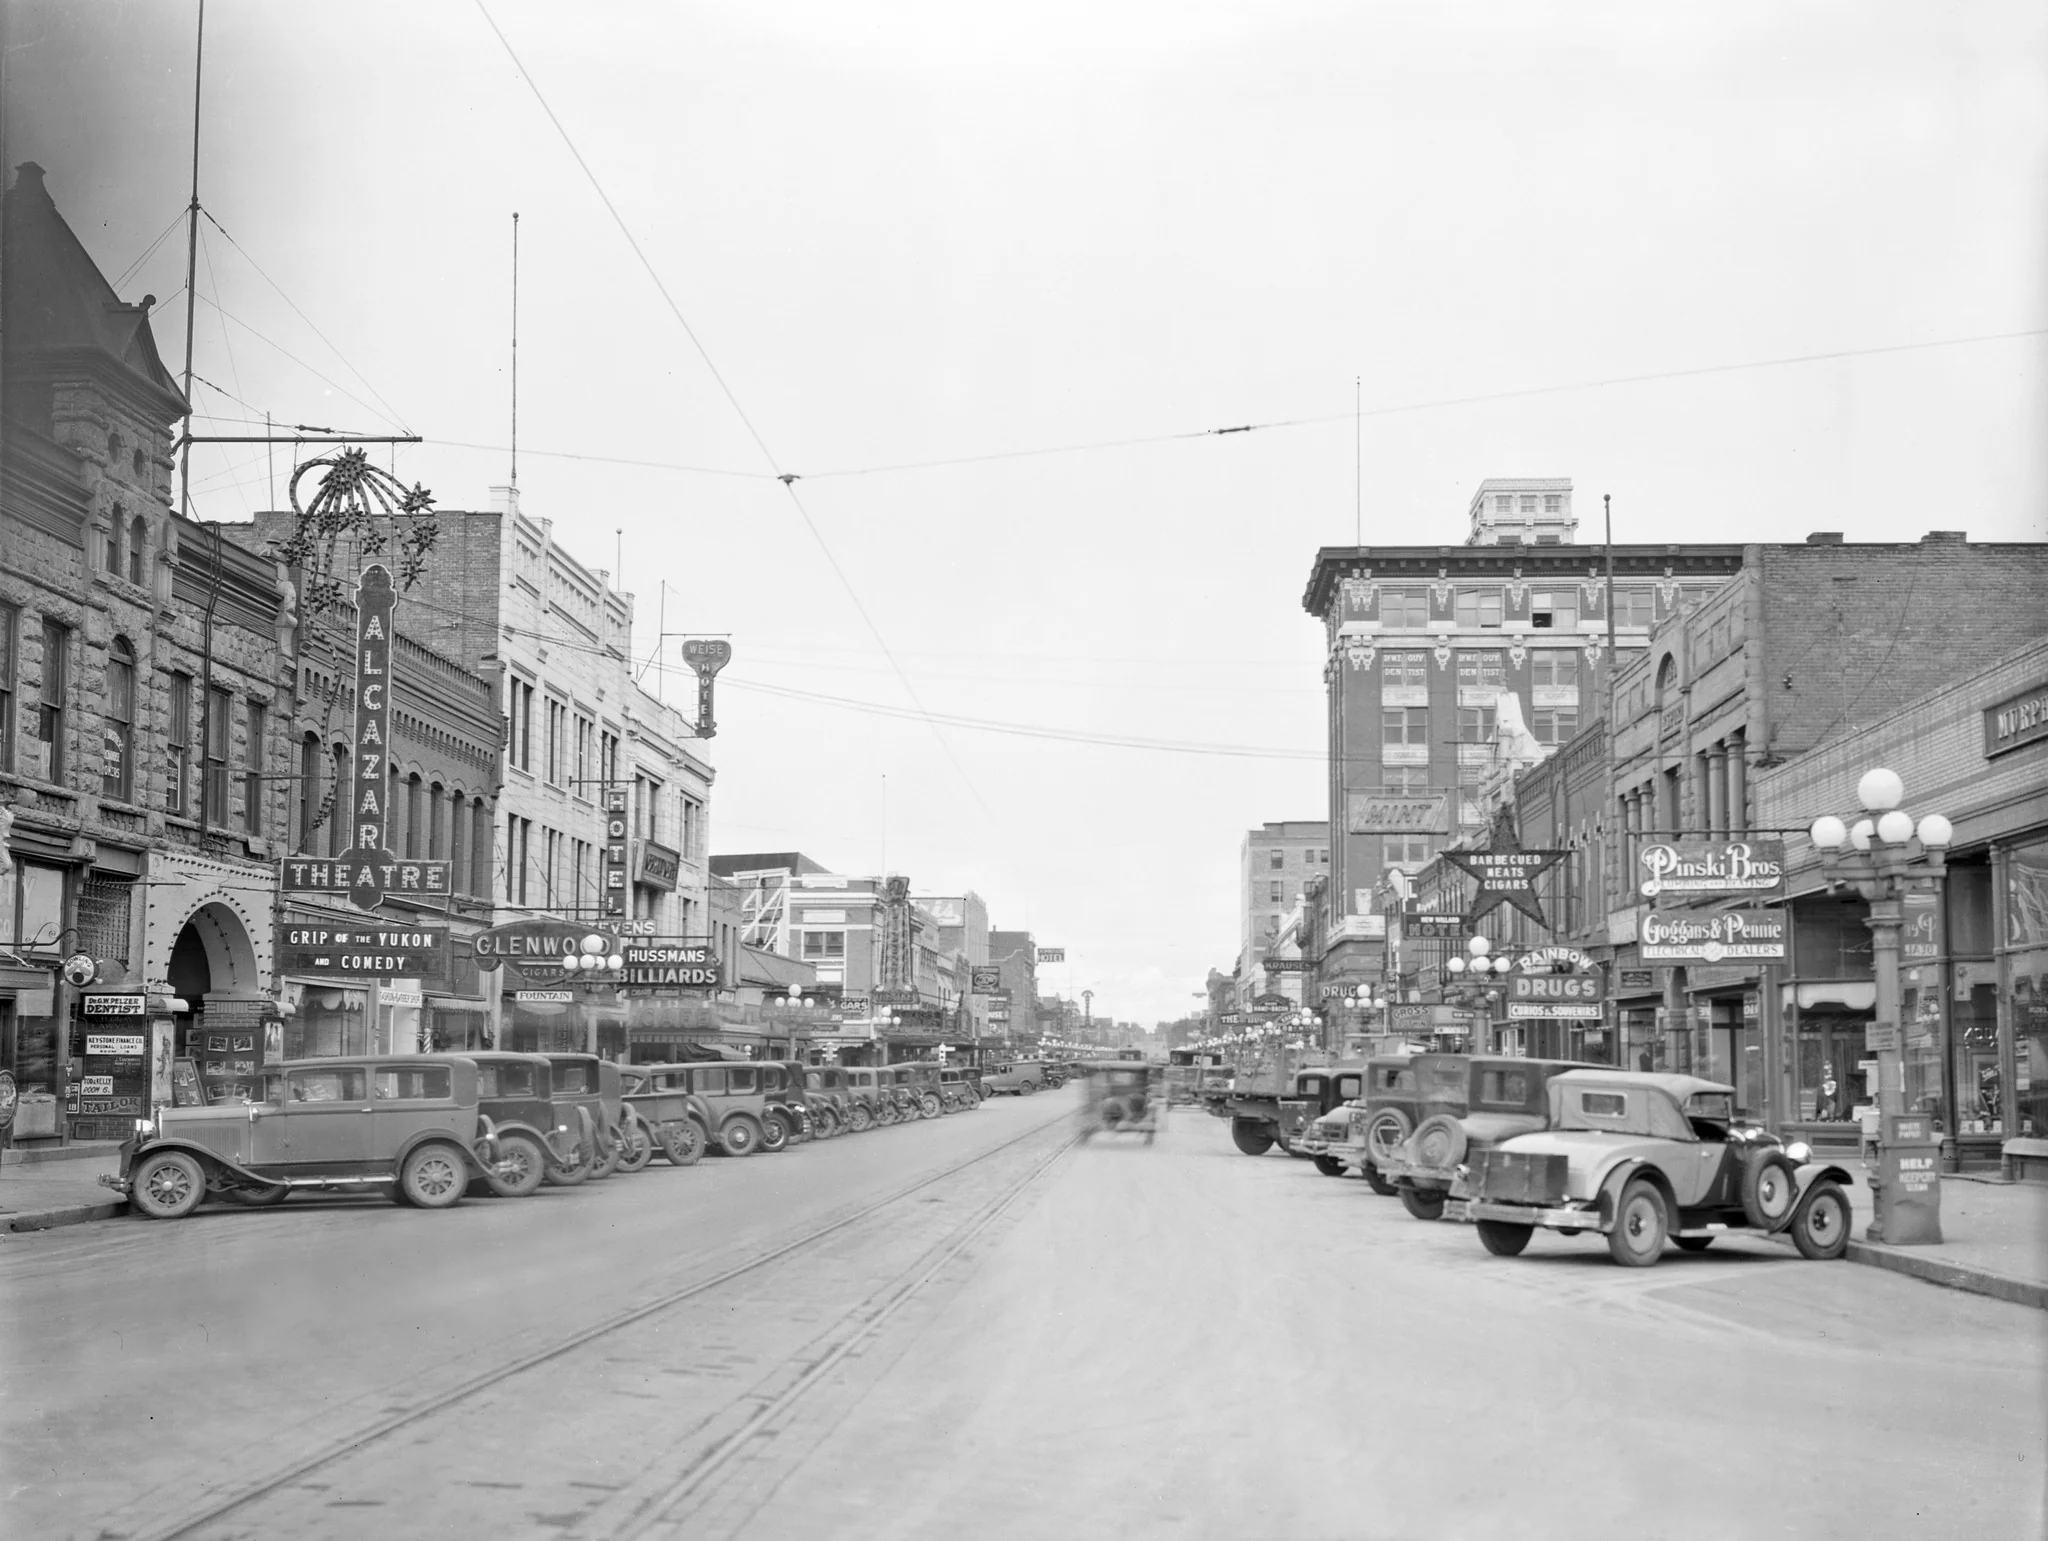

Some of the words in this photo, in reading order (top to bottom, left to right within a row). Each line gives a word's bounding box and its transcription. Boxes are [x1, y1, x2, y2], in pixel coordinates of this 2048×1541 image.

[689, 644, 724, 656] WEISE
[700, 663, 711, 729] HOTEL
[358, 614, 385, 851] ALCAZAR
[1364, 803, 1432, 825] MINT
[608, 793, 626, 915] HOTEL
[1469, 854, 1542, 865] BARBECUED
[1487, 867, 1525, 877] MEATS
[1641, 843, 1726, 888] Pinski
[1725, 842, 1784, 879] Bros.
[290, 863, 443, 890] THEATRE
[1484, 879, 1529, 890] CIGARS
[1408, 923, 1474, 937] HOTEL
[1642, 914, 1709, 945] Goggans
[1710, 917, 1722, 939] &
[1722, 912, 1782, 944] Pennie
[290, 930, 328, 945] GRIP
[335, 933, 349, 943] OF
[355, 935, 371, 944] THE
[379, 932, 432, 948] YUKON
[628, 949, 706, 963] HUSSMANS
[1727, 945, 1778, 956] DEALERS
[66, 955, 93, 968] BOWLING
[314, 957, 330, 966] AND
[341, 955, 406, 970] COMEDY
[1518, 947, 1594, 970] RAINBOW
[522, 967, 566, 978] CIGARS
[617, 968, 718, 985] BILLIARDS
[1322, 985, 1357, 998] DRUG
[1516, 977, 1597, 998] DRUGS
[110, 997, 140, 1005] PELZER
[518, 991, 571, 1001] FOUNTAIN
[86, 1004, 141, 1014] DENTIST
[1393, 1005, 1430, 1019] GROSS
[1511, 1005, 1545, 1017] CURIOS
[1551, 1005, 1598, 1017] SOUVENIRS
[1220, 1015, 1239, 1024] THE
[83, 1086, 100, 1094] ROOM
[82, 1097, 139, 1113] TAILOR
[1899, 1158, 1933, 1170] HELP
